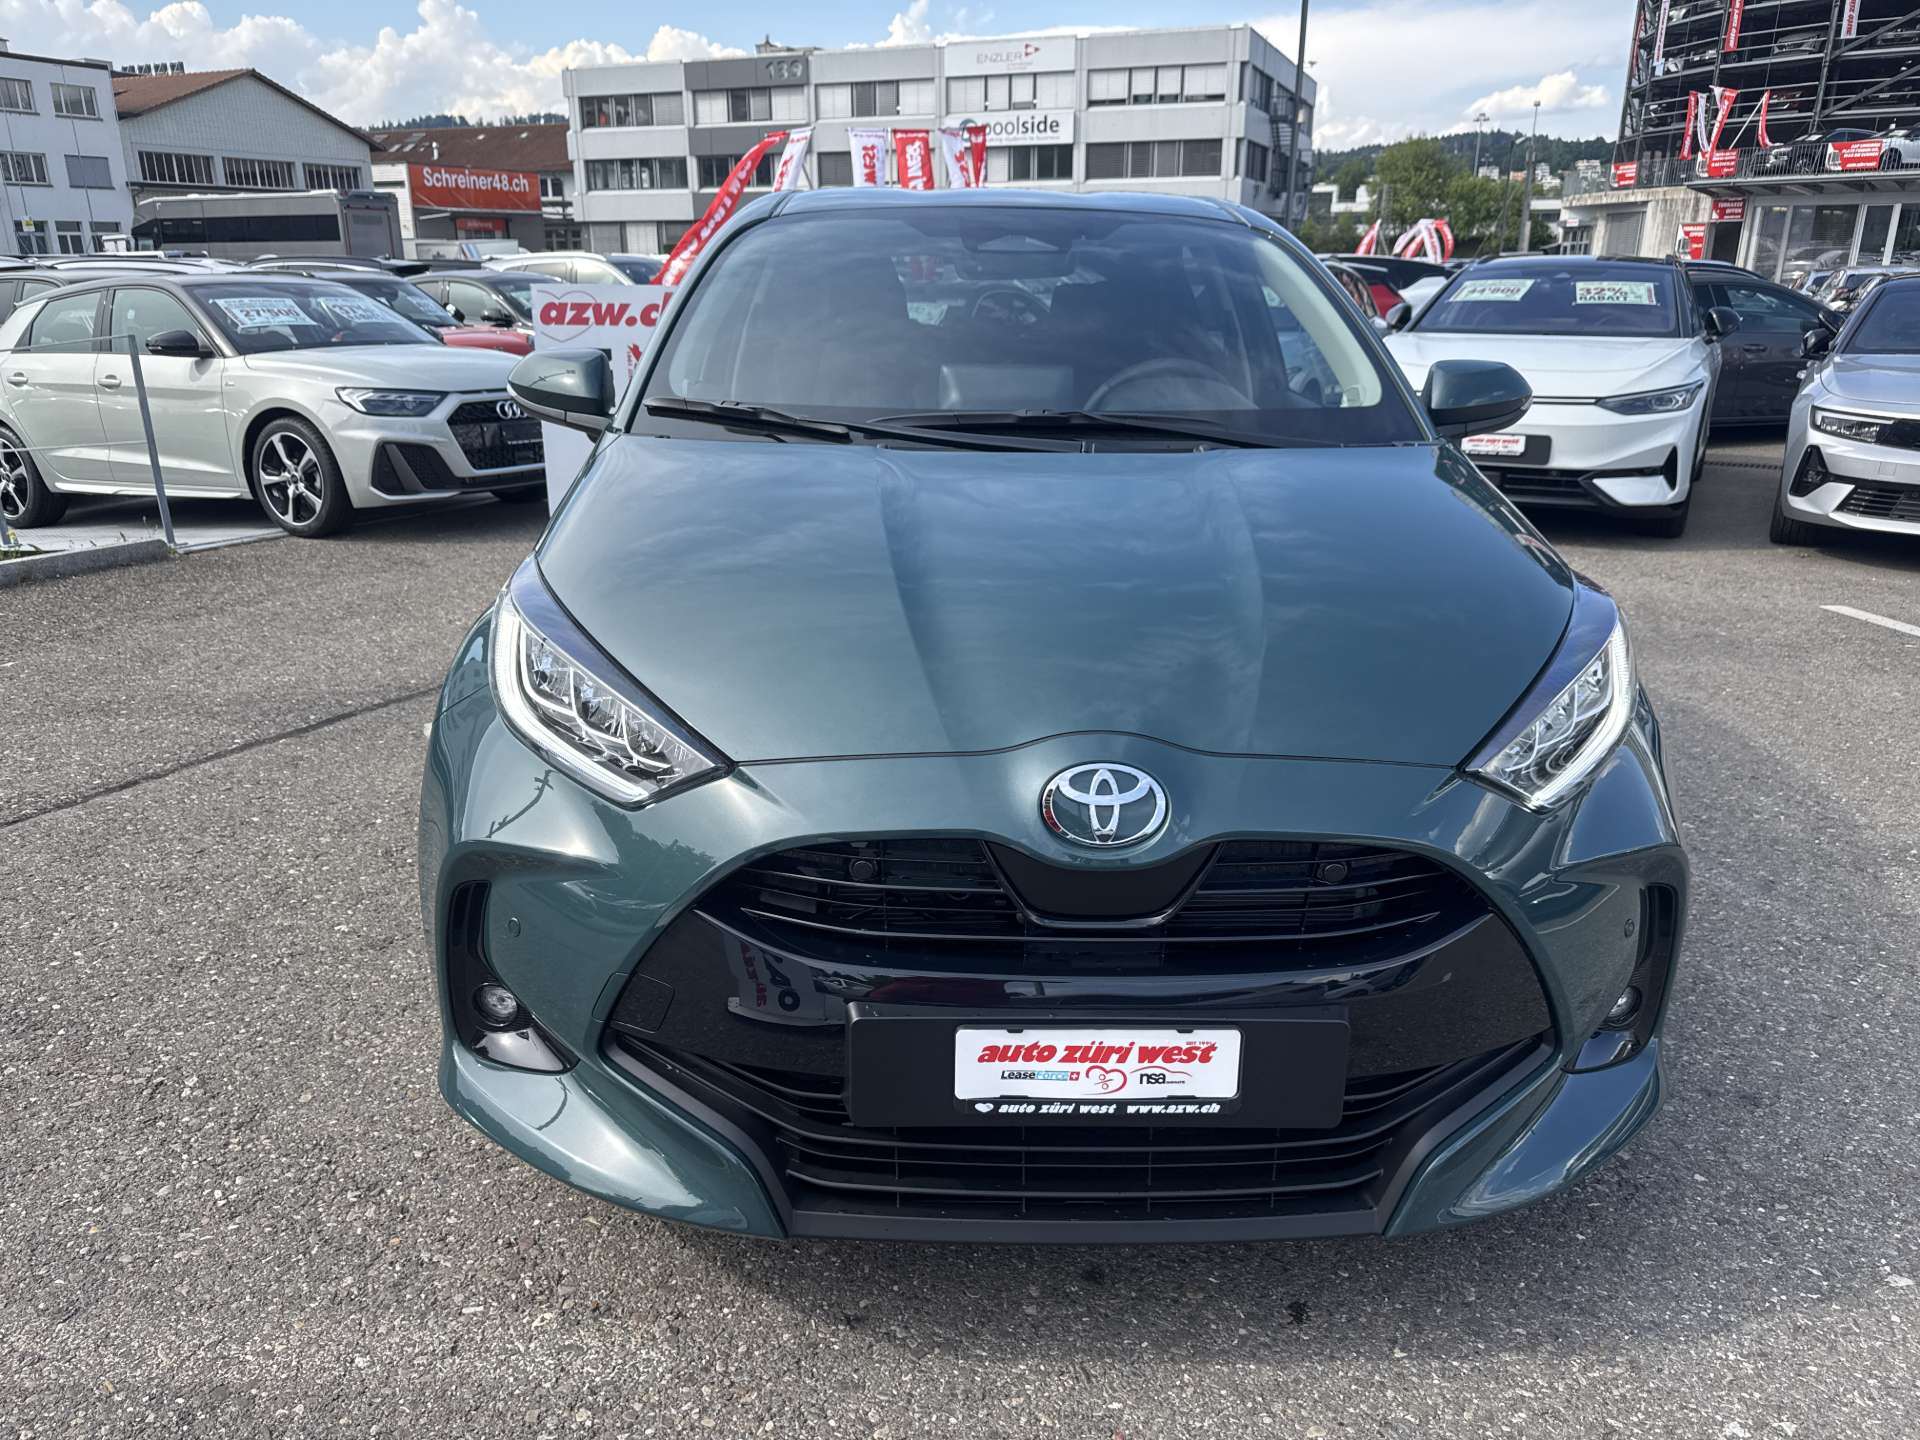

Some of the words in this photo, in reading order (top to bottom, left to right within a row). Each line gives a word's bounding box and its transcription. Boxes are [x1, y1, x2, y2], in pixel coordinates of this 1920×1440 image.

[976, 51, 1023, 64] ENZLER
[766, 60, 803, 80] 139
[423, 166, 529, 192] Schreiner48.ch
[977, 1041, 1057, 1063] auto
[1057, 1041, 1135, 1064] züri
[1138, 1042, 1217, 1064] west
[1139, 1073, 1166, 1085] nsa
[998, 1103, 1036, 1114] auto
[1038, 1102, 1076, 1114] züri
[1079, 1104, 1117, 1114] west
[1126, 1103, 1221, 1114] www.azw.ch
